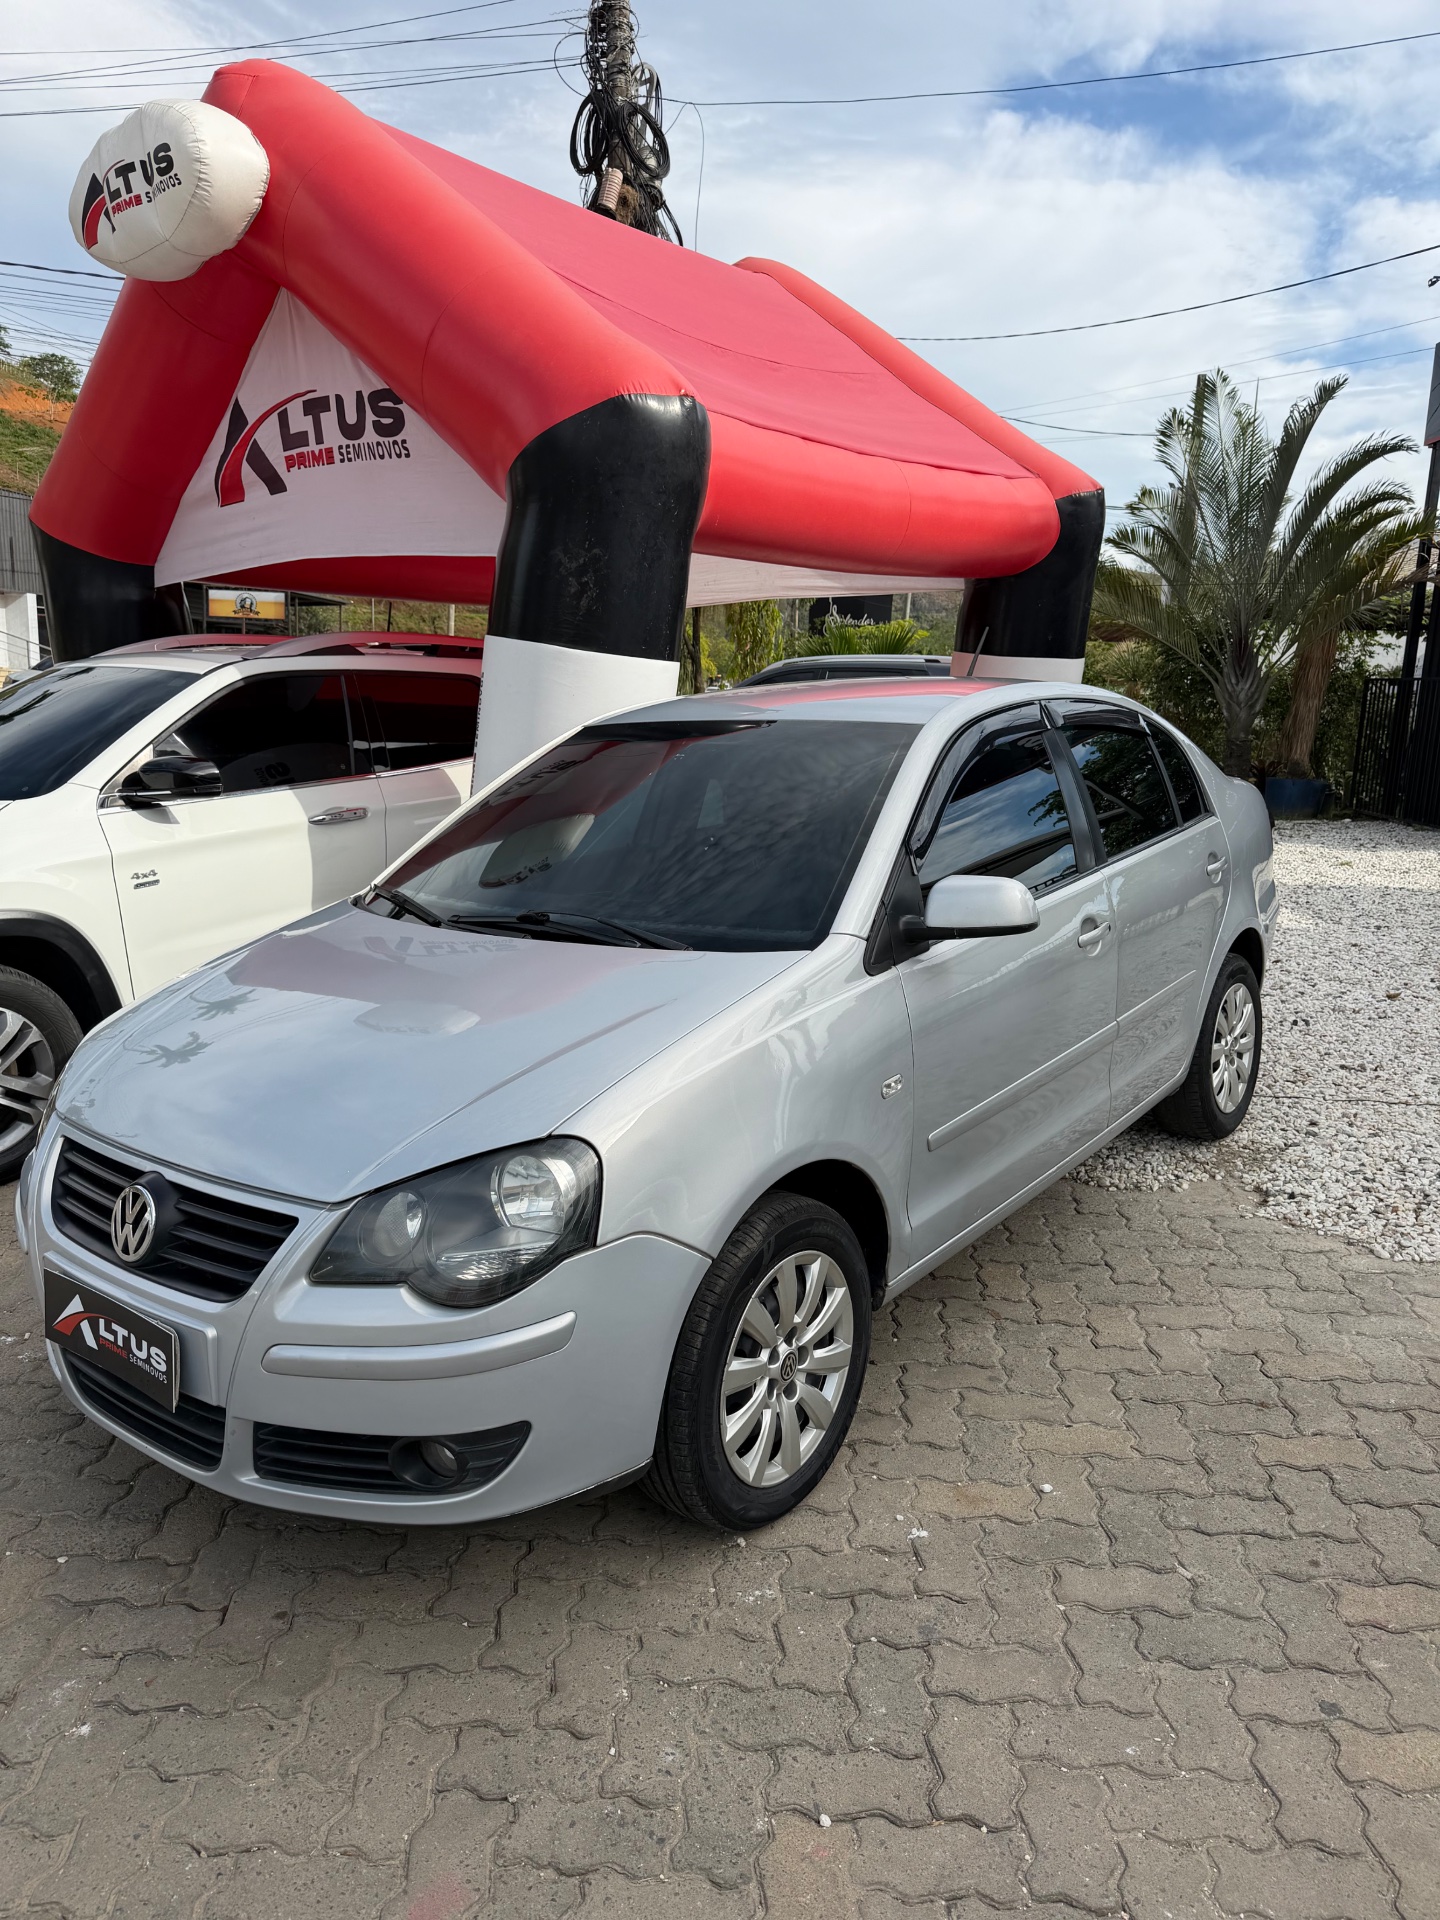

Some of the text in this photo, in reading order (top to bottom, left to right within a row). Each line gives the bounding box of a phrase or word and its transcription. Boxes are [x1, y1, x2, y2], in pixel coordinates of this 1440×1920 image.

[82, 142, 175, 250] ALTUS
[111, 173, 182, 217] PRIME SNOVOS
[214, 387, 406, 508] ALTUS
[284, 438, 411, 473] PRIME SEMINOVOS
[111, 1185, 156, 1263] VW
[52, 1294, 167, 1372] ALTUS
[99, 1337, 168, 1384] PRIME SEMINOVOS
